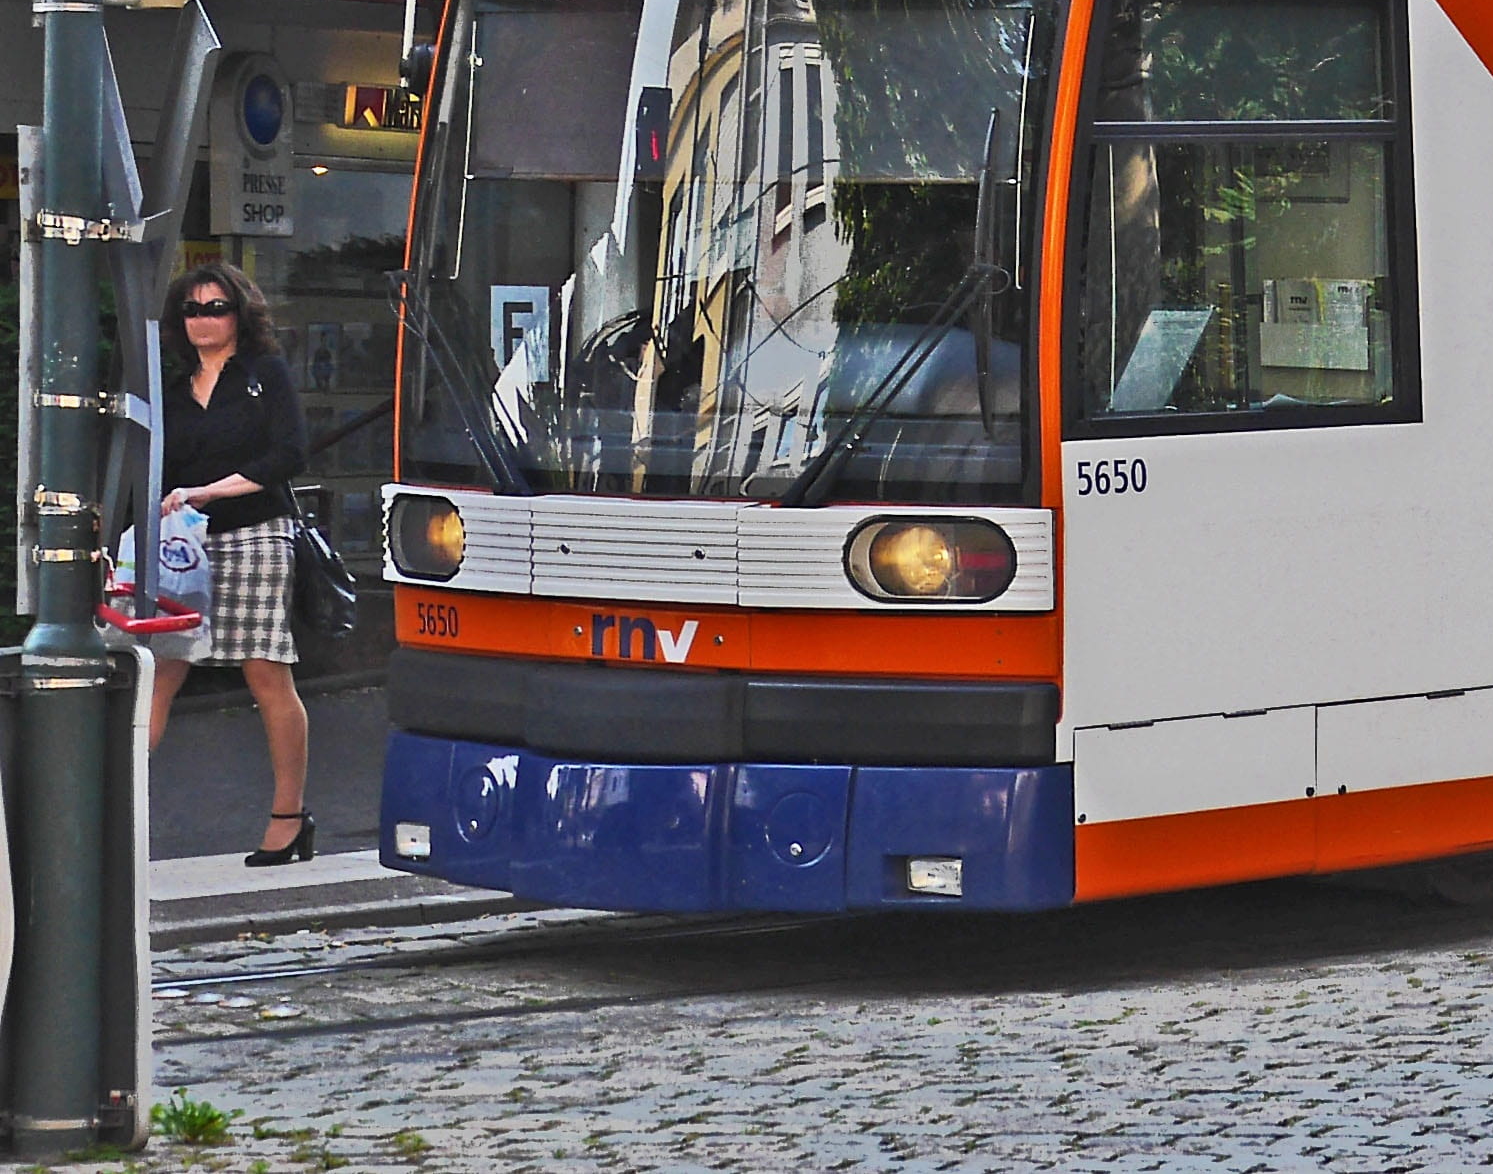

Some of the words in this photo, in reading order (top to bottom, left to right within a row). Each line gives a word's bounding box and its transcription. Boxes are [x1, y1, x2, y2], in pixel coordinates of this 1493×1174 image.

[243, 173, 286, 195] PRESSE
[243, 202, 285, 224] SHOP
[502, 301, 533, 367] F
[1077, 458, 1147, 496] 5650
[417, 601, 459, 638] 5650
[591, 613, 699, 664] rnv
